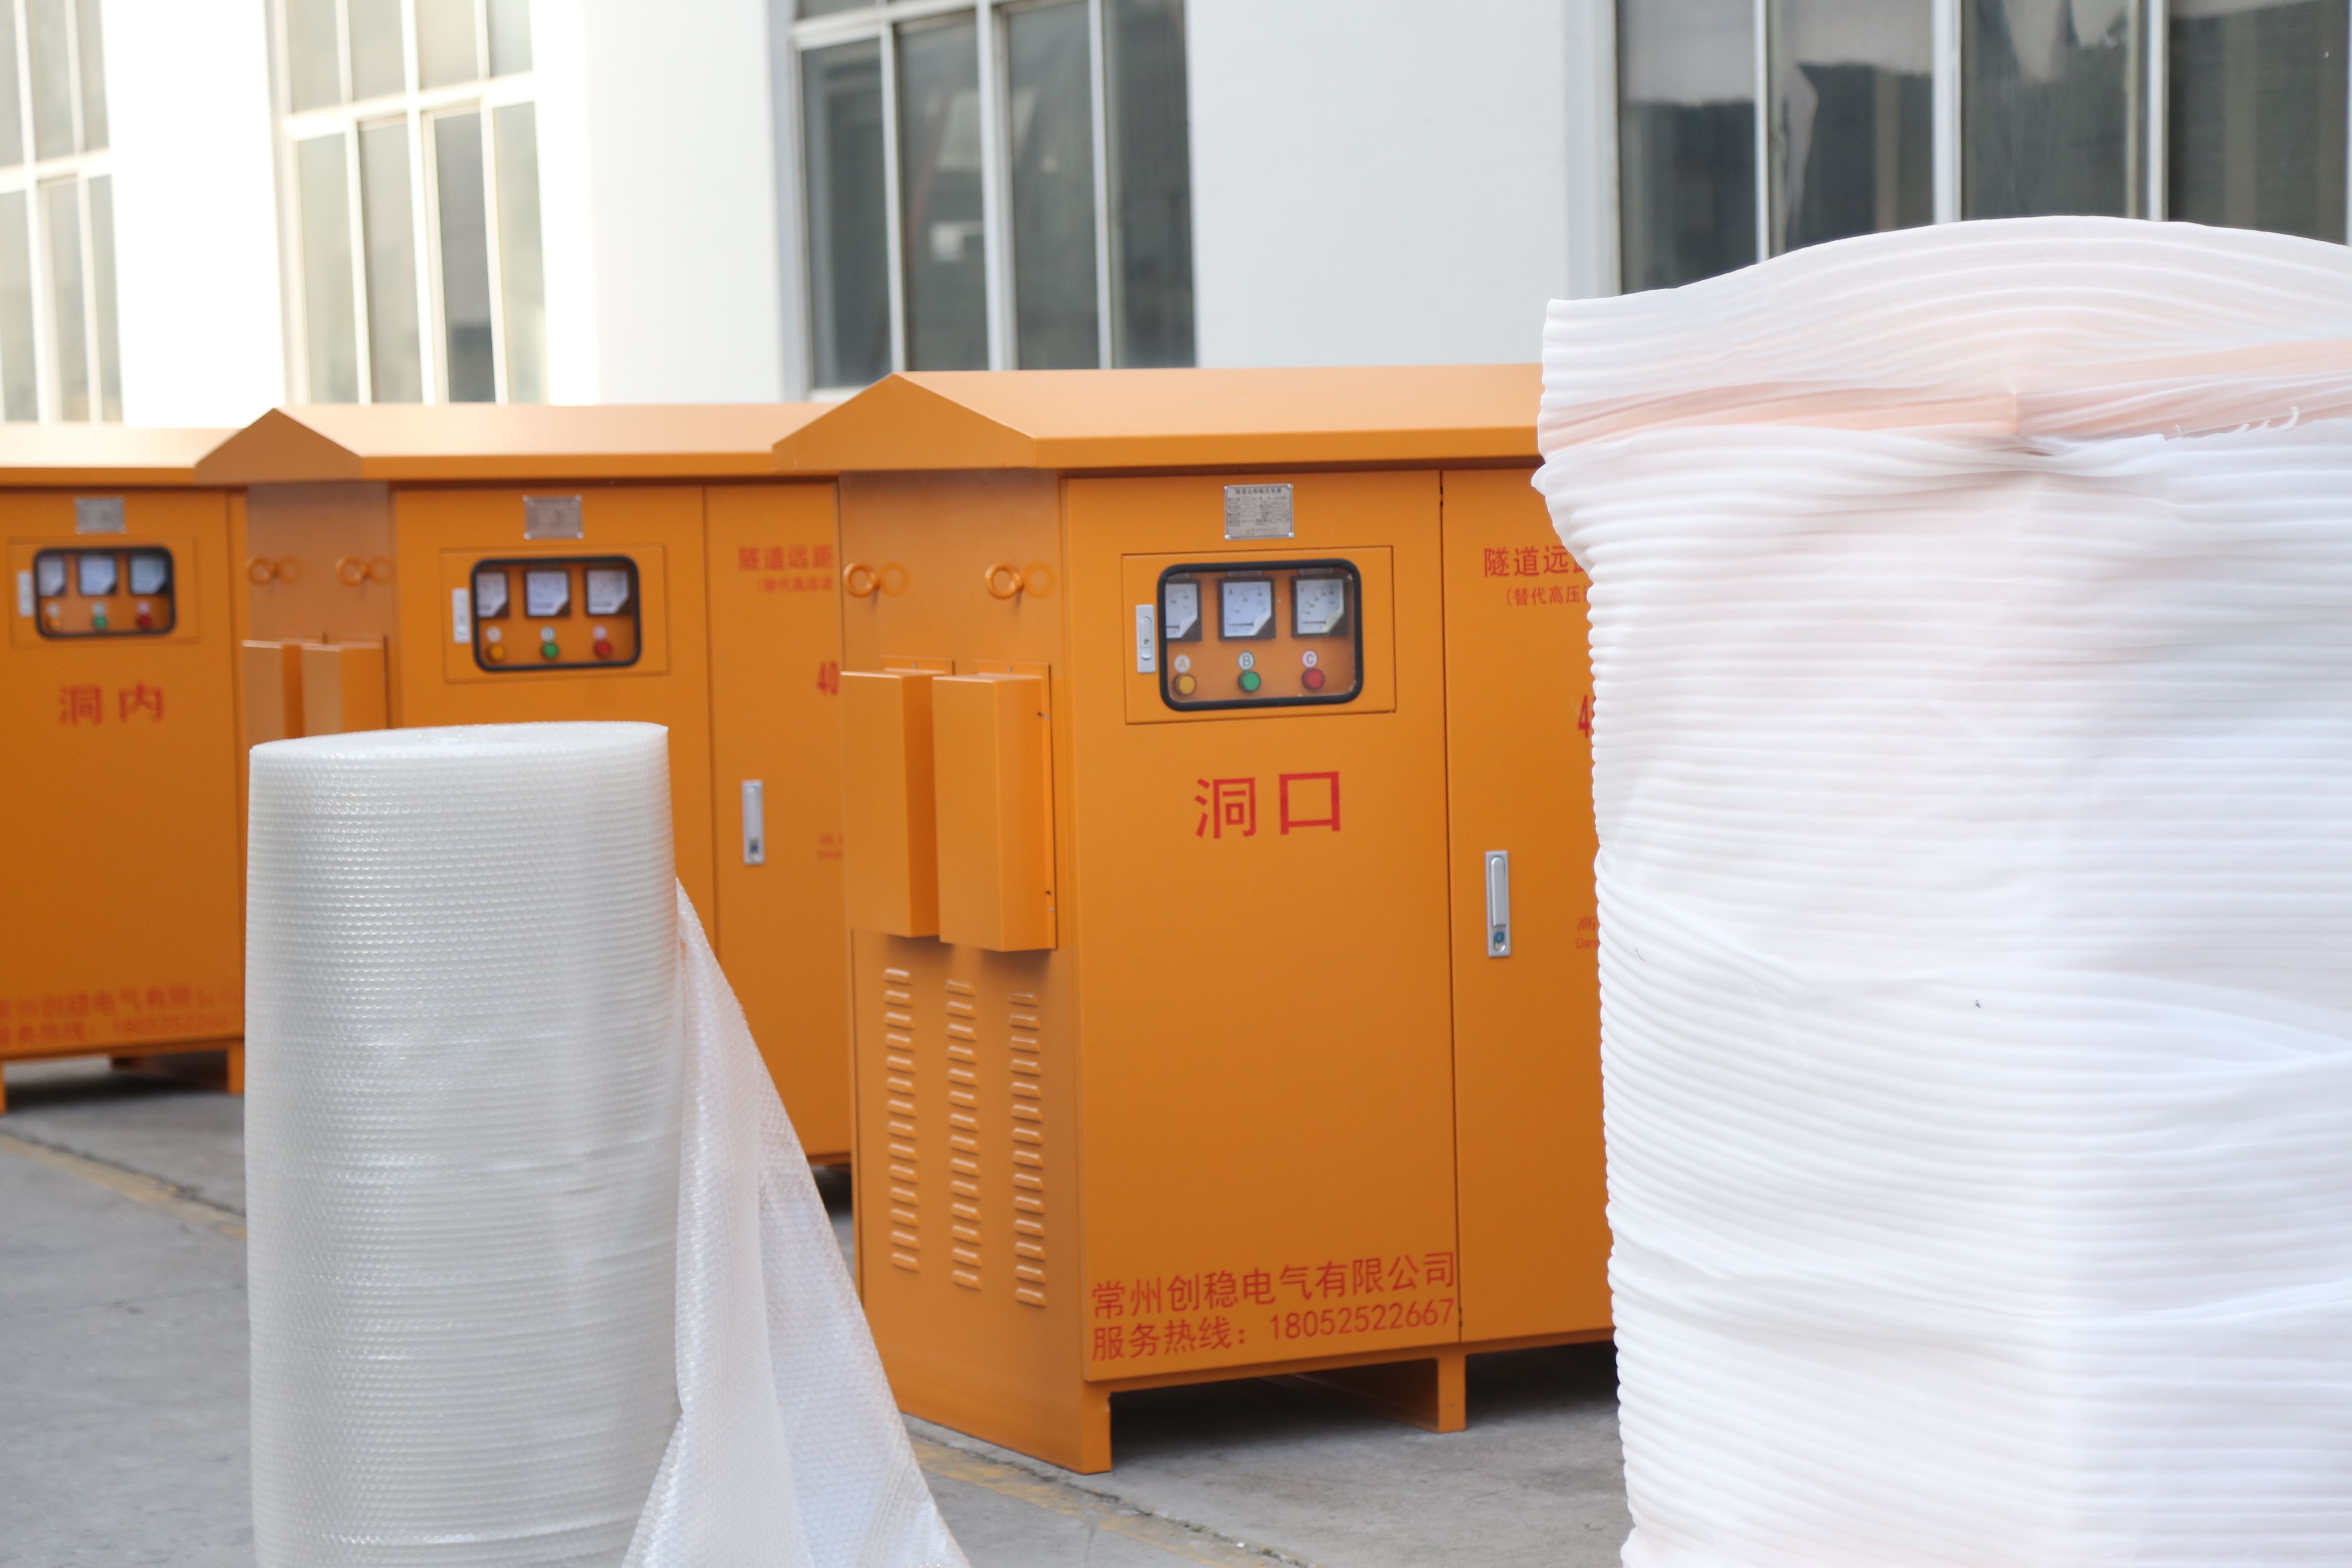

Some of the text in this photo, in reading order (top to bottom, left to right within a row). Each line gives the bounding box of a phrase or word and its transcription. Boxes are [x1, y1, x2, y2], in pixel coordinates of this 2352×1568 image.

[818, 660, 839, 695] 40
[59, 683, 164, 726] 洞内
[1578, 694, 1596, 738] 4
[1194, 771, 1341, 839] 洞口
[1092, 1252, 1455, 1320] 常州创稳电气有限公司
[1092, 1298, 1455, 1361] 服务热线： 18052522667
